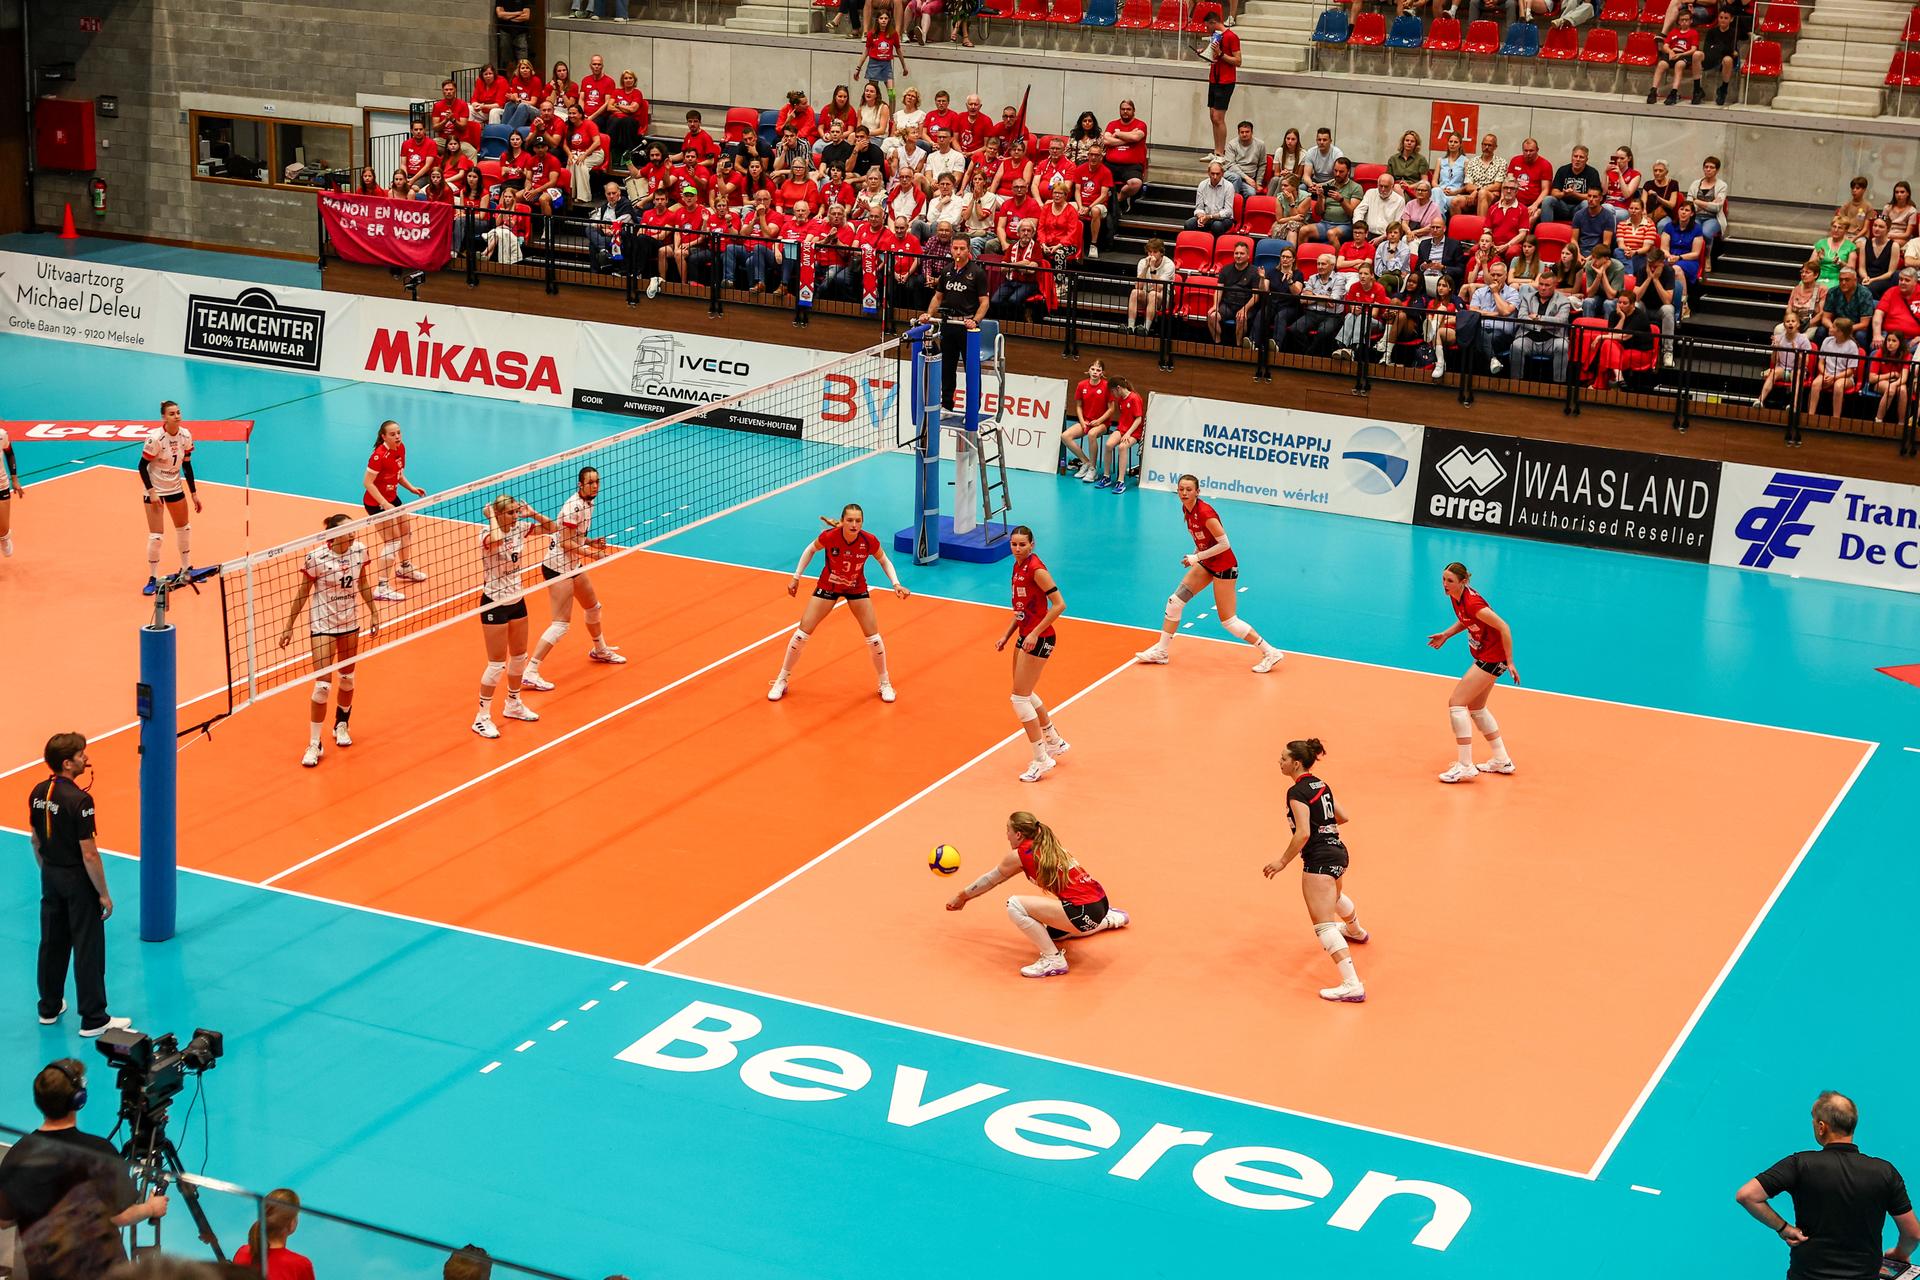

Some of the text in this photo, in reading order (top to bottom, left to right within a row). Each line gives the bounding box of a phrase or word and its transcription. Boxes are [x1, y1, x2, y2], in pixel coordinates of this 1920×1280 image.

[323, 196, 431, 225] MANON EN NOOR
[367, 223, 385, 237] ER
[393, 226, 431, 241] VOOR
[37, 261, 124, 293] Uitvaartzorg
[17, 284, 141, 319] Michael Deleu
[9, 316, 36, 330] Grote
[38, 320, 60, 333] Baan
[63, 325, 76, 336] 129
[85, 329, 105, 340] 9120
[108, 331, 145, 345] Melsele
[197, 308, 314, 341] TEAMCENTER
[202, 332, 304, 357] 100% TEAMWEAR
[679, 355, 750, 377] IVECO
[581, 395, 797, 432] GOOIK ANTWERPEN ST-LIEVENS-HOUTEM
[1151, 434, 1330, 470] LINKERSCHELDEOEVER
[1203, 423, 1332, 452] MAATSCHAPPIJ
[1148, 469, 1329, 505] De Wslandhaven wérkt!
[1523, 460, 1710, 520] WAASLAND
[1518, 506, 1705, 547] Authorised Reseller
[1844, 493, 1920, 531] Tran
[842, 561, 851, 573] 3
[1838, 532, 1920, 570] De C
[339, 575, 353, 589] 12
[612, 999, 1474, 1254] Beveren
